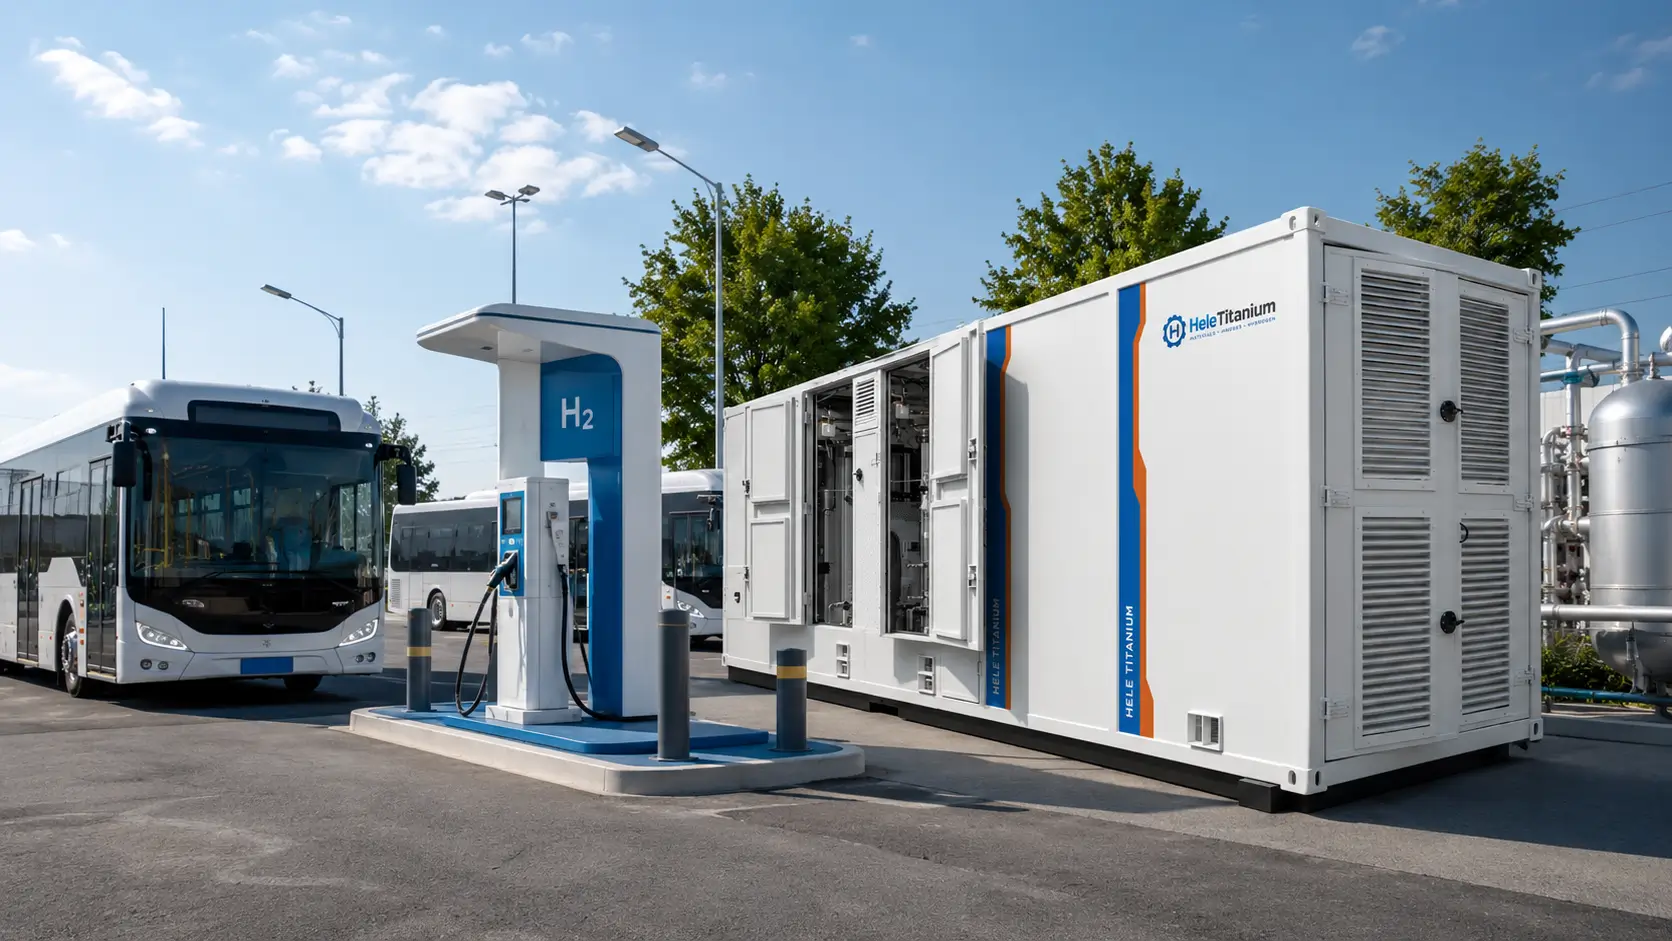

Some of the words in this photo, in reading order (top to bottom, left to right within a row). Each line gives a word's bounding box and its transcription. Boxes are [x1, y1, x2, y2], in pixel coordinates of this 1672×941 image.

[1189, 301, 1276, 333] HeleTitanium
[992, 598, 1000, 658] TITANIUM
[1125, 605, 1134, 674] TITANIUM
[992, 662, 1000, 695] HELE
[1125, 679, 1134, 718] HELE
